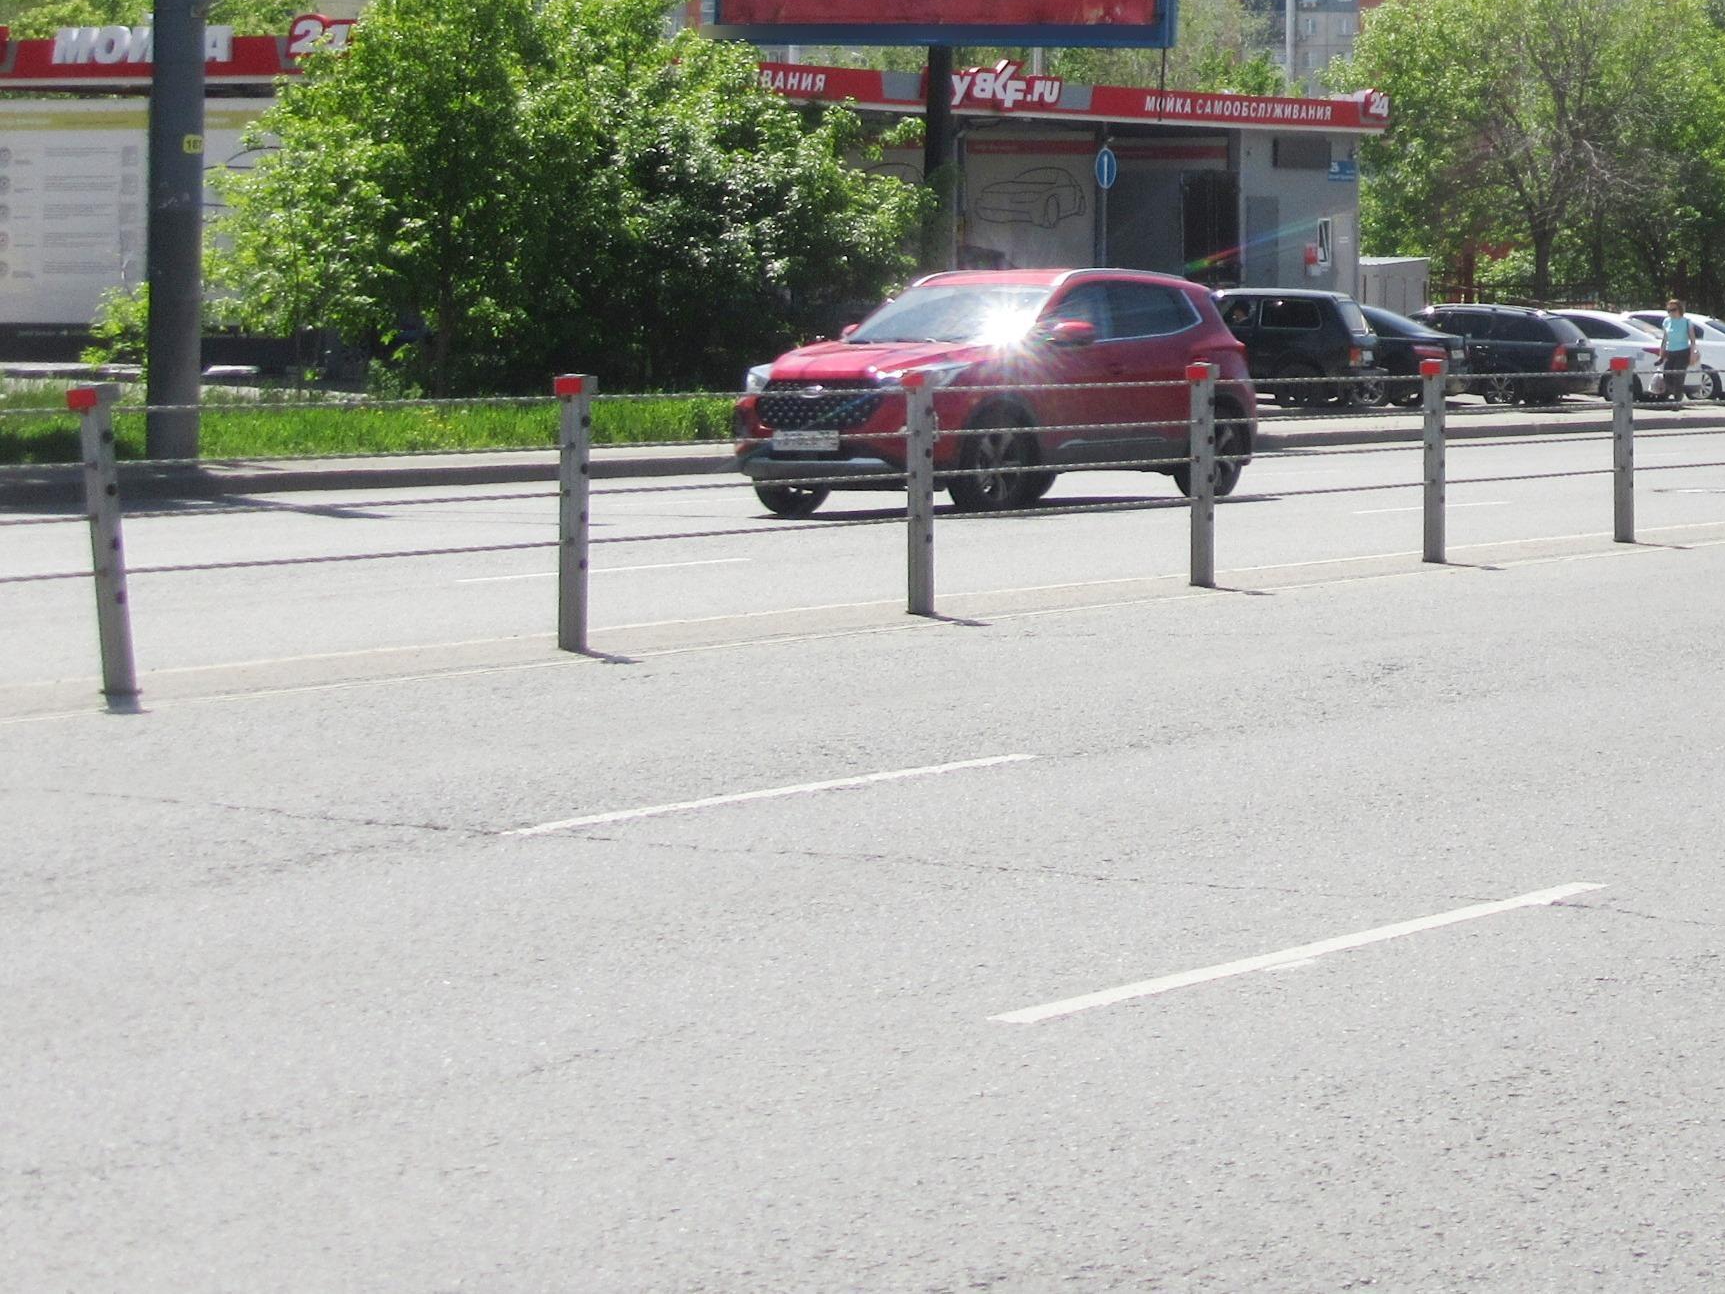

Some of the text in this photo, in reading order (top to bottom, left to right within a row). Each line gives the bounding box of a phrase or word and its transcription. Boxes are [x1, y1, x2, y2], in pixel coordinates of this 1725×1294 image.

[1145, 95, 1332, 121] МОЙКА САМООБСЛУЖИВАНИЯ
[1370, 92, 1389, 117] 24
